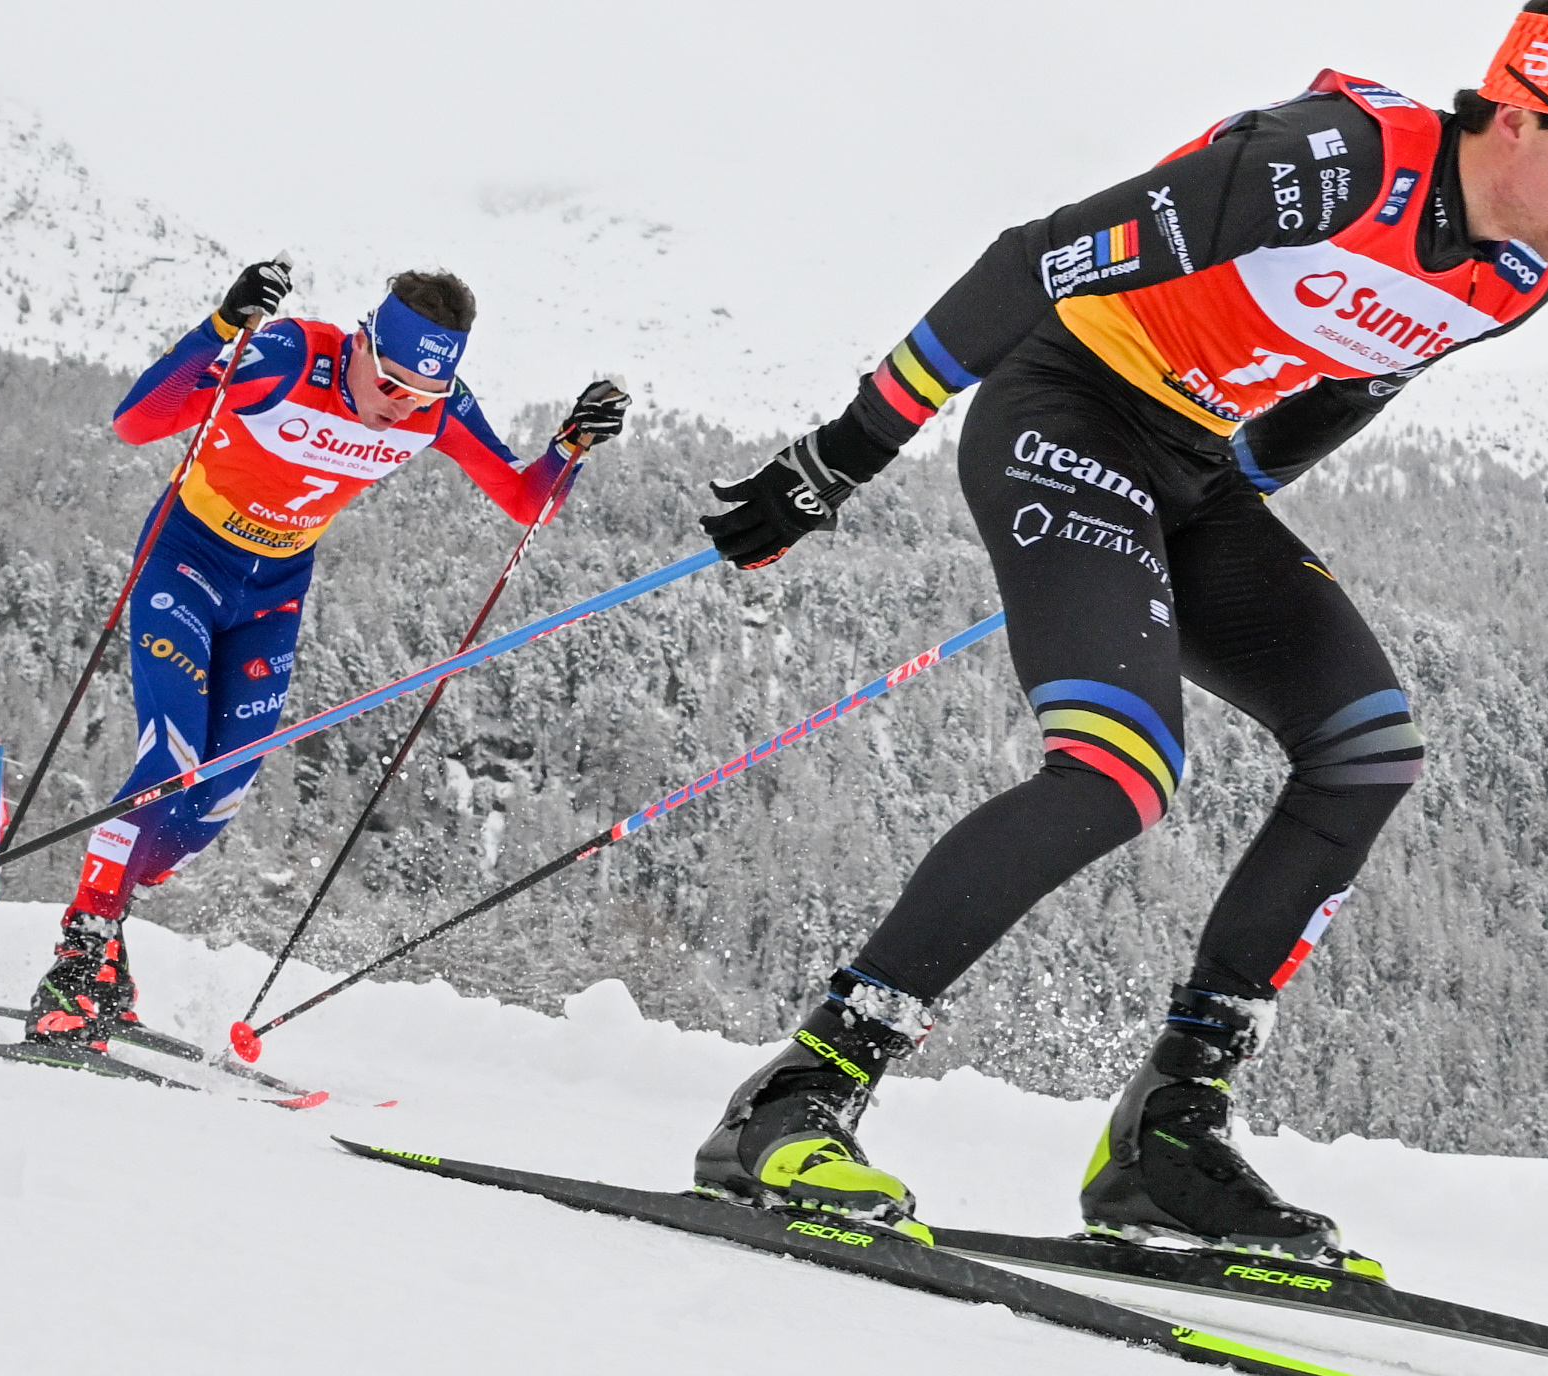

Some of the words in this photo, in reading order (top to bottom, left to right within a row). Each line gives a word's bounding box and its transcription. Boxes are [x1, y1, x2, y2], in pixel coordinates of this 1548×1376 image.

[1335, 166, 1351, 201] Aker
[1499, 252, 1538, 285] coop
[1335, 287, 1456, 358] Sunris
[419, 336, 450, 356] Villard
[1313, 324, 1353, 347] DREAM
[1370, 351, 1390, 364] DO
[213, 428, 230, 450] 7
[310, 428, 412, 464] Sunrise
[284, 474, 340, 511] 7
[1030, 473, 1076, 495] Andorrà
[248, 502, 327, 528] ENGADIN
[1067, 510, 1134, 536] Residencial
[1056, 521, 1170, 589] ALTAVIST
[236, 689, 288, 720] CRAF
[98, 827, 133, 847] Sunrise
[88, 860, 103, 883] 7
[786, 1220, 874, 1248] FISCHER
[1224, 1264, 1333, 1292] FISCHER
